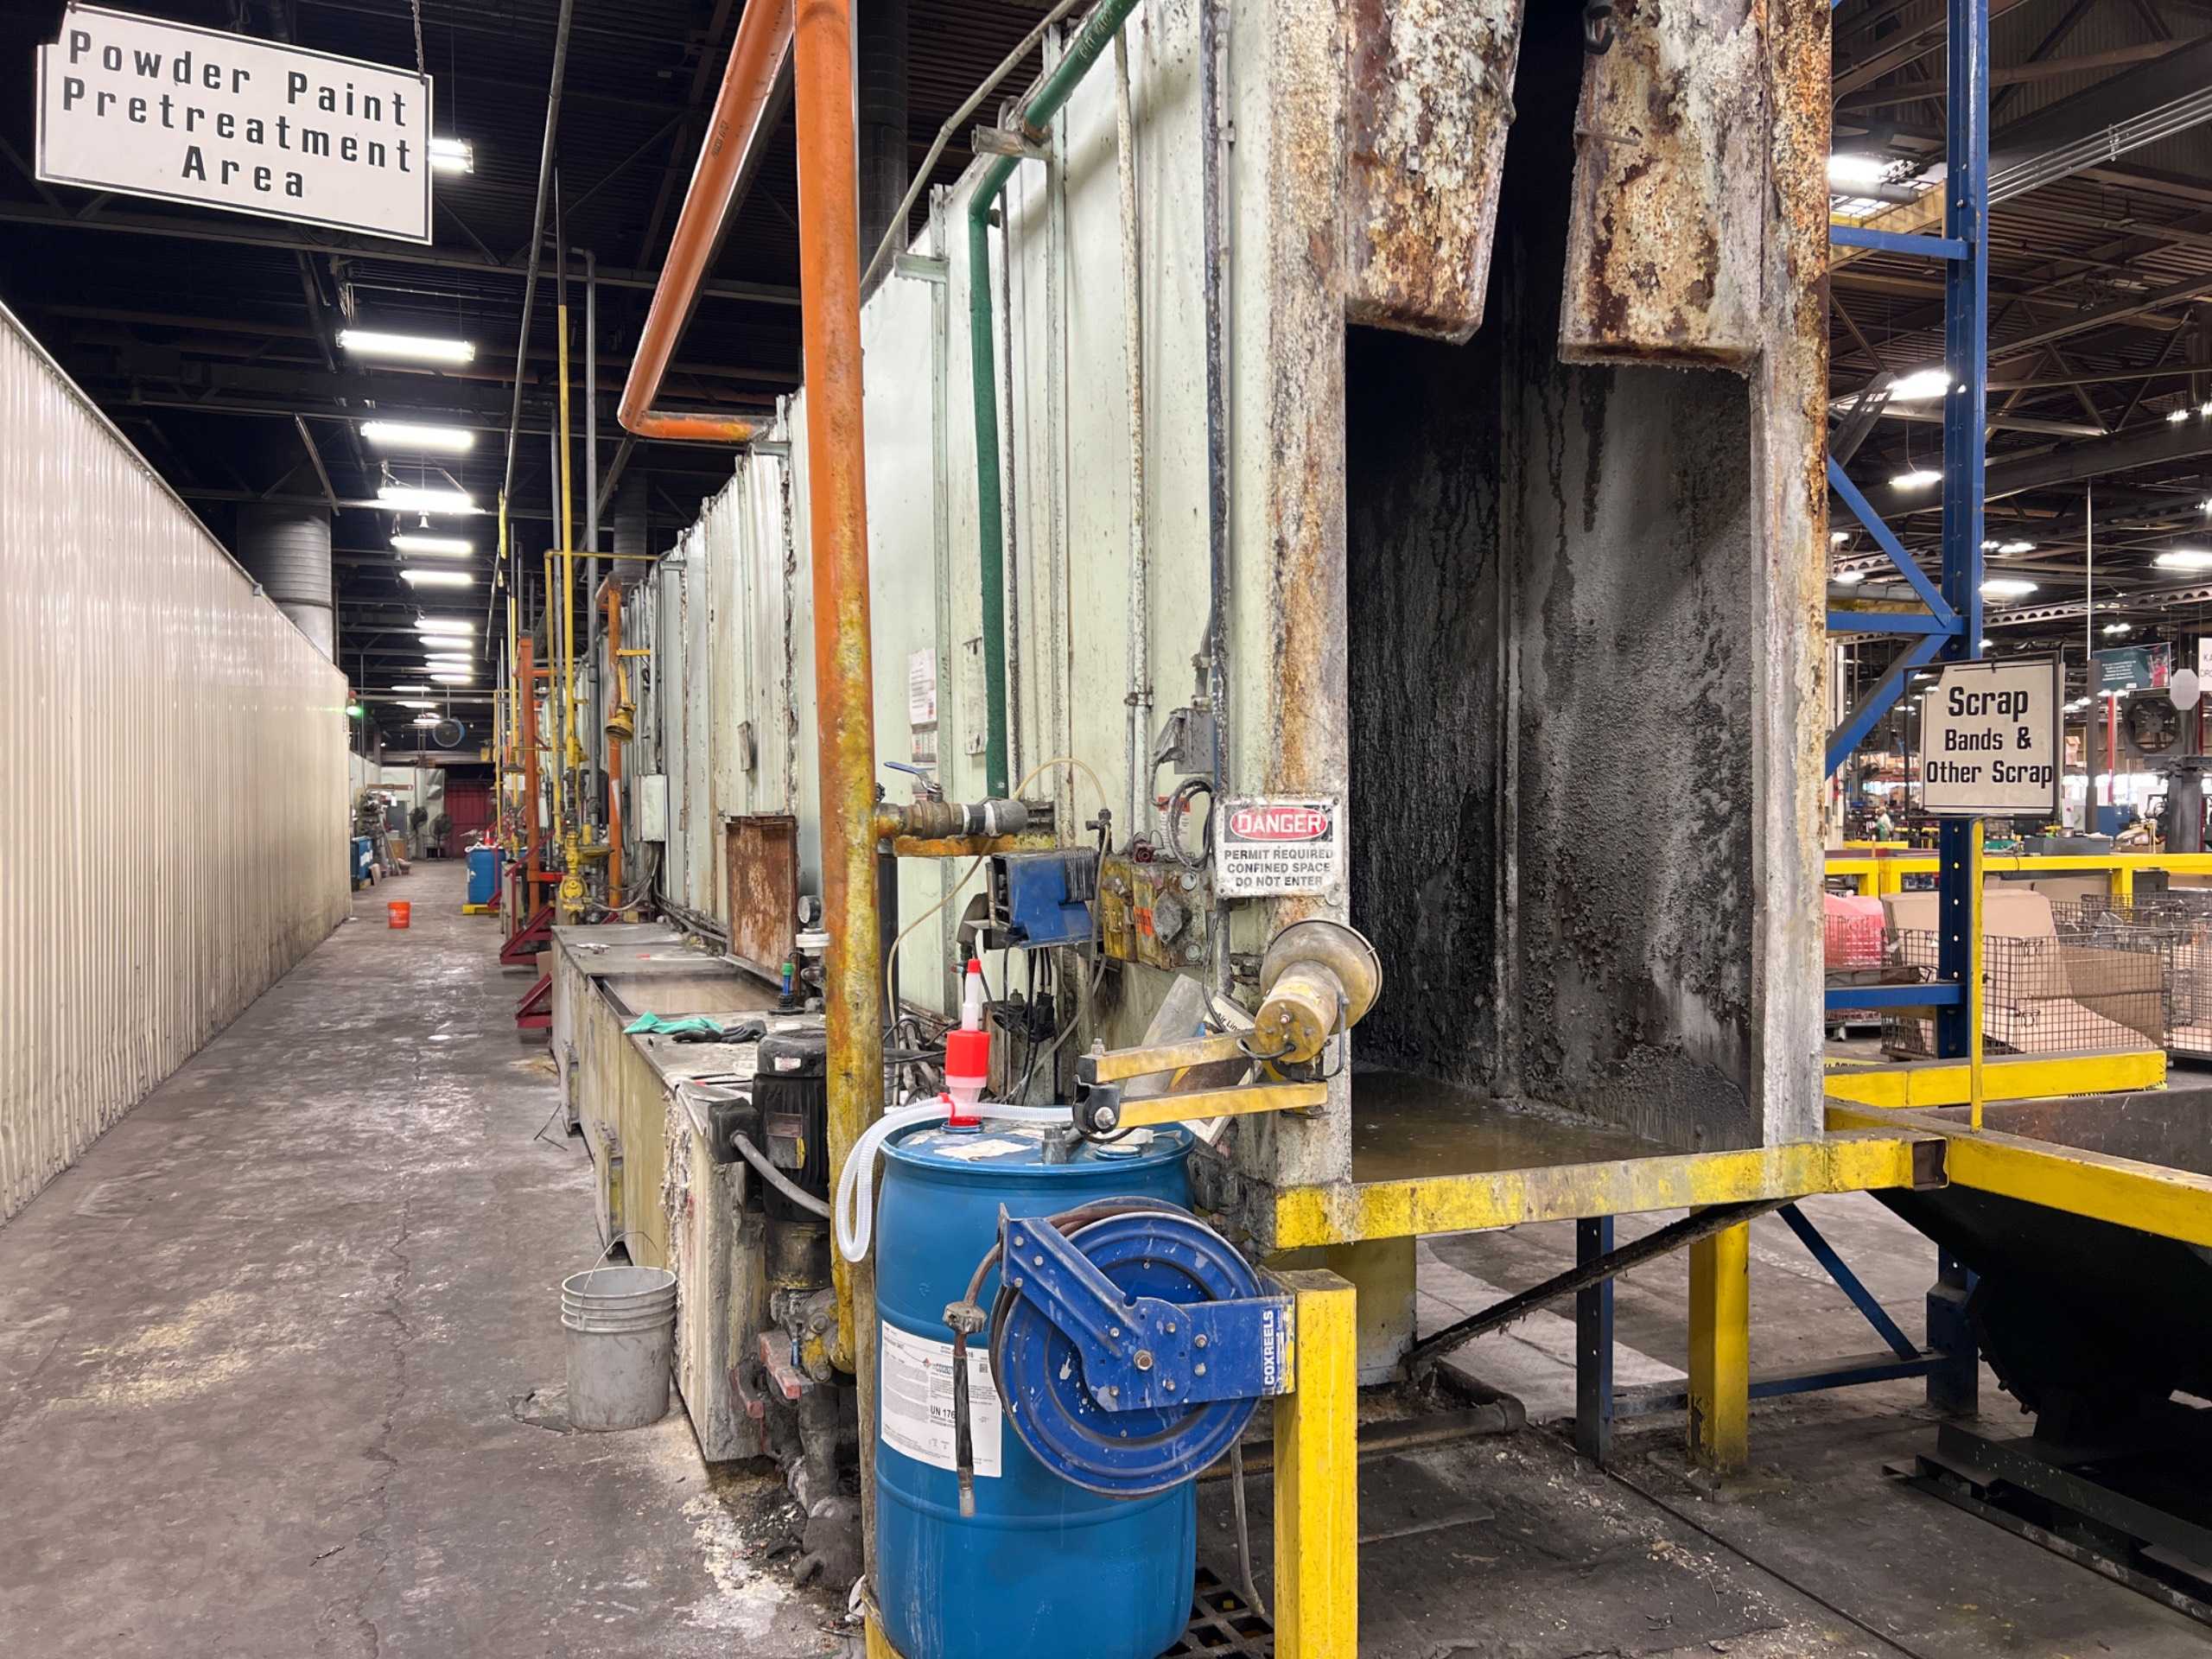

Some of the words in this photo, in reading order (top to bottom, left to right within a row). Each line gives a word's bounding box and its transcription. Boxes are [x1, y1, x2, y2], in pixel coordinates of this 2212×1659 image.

[68, 29, 251, 93] Powder
[287, 71, 406, 126] Paint
[63, 76, 410, 173] Pretreatment
[181, 145, 303, 198] Area
[1948, 686, 2029, 722] Scrap
[1944, 728, 2003, 751] Bands
[2017, 727, 2031, 749] &
[1926, 761, 1982, 783] Other
[1992, 760, 2052, 789] Scrap
[1236, 814, 1321, 833] DANGER
[1224, 849, 1269, 860] PERMIT
[1273, 849, 1333, 859] REQUIRED
[1227, 863, 1288, 874] CONFINED
[1292, 862, 1331, 873] SPACE
[1236, 877, 1252, 887] DO
[1256, 876, 1281, 887] NOT
[1285, 876, 1323, 887] ENTER
[1262, 1310, 1275, 1386] COXREELS
[930, 1404, 941, 1416] UN
[943, 1408, 957, 1420] 176
